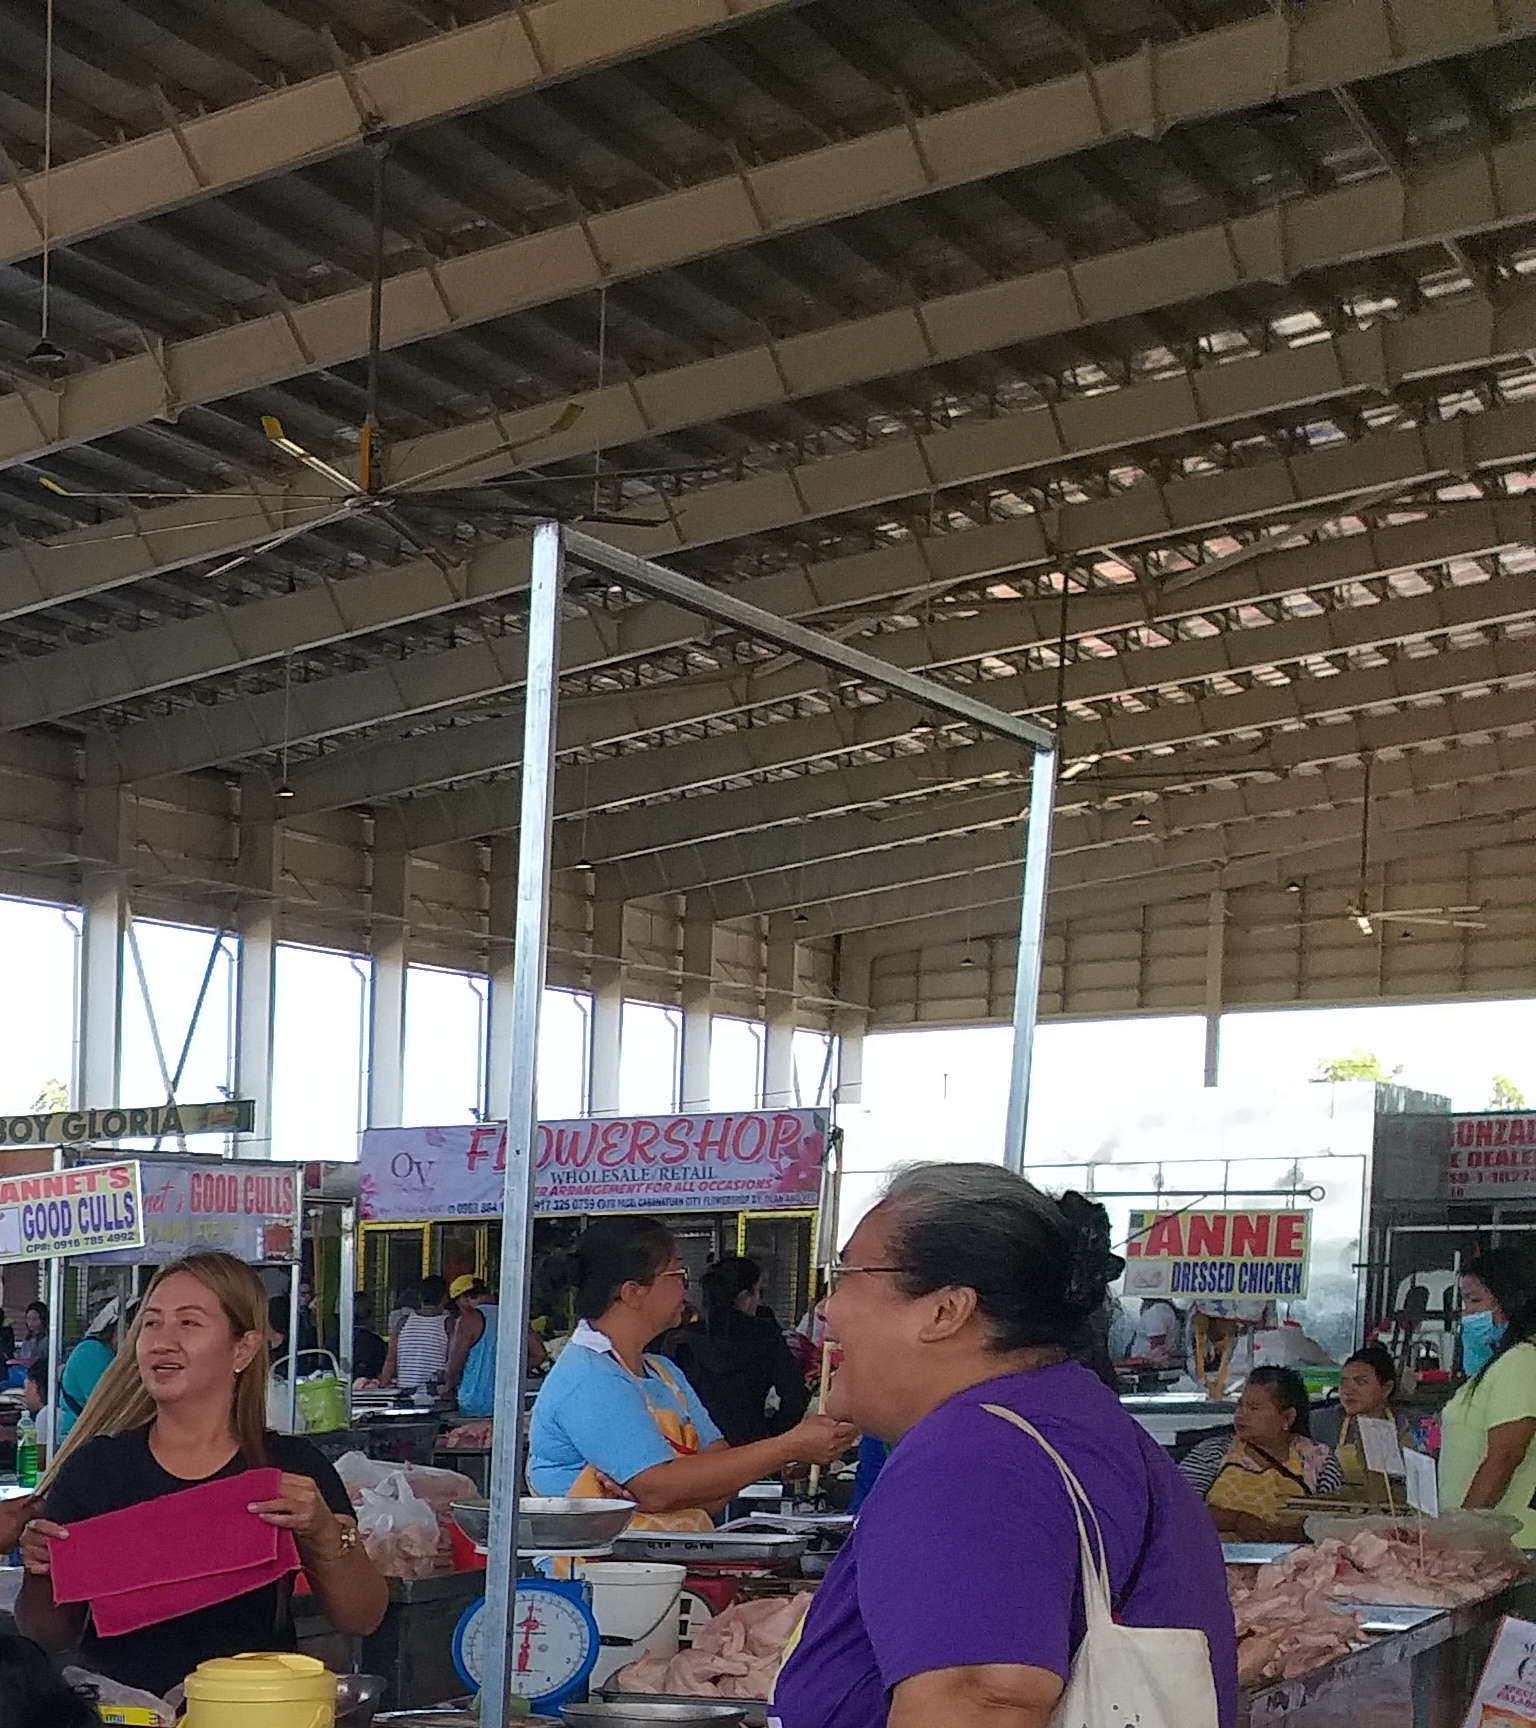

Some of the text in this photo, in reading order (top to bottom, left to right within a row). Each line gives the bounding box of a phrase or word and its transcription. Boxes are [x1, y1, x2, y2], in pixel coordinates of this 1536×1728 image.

[62, 1105, 185, 1140] GLORIA
[190, 1172, 239, 1214] GOOD
[243, 1174, 293, 1215] CULLS
[550, 1182, 647, 1196] ARRANGEMENT
[646, 1182, 675, 1193] FOR
[676, 1180, 694, 1192] ALL
[699, 1178, 772, 1192] OCCASIONS
[23, 1199, 73, 1243] GOOD
[78, 1191, 136, 1235] CULLS
[107, 1231, 135, 1243] 4992
[1170, 1262, 1304, 1295] DRESSED CHICKEN
